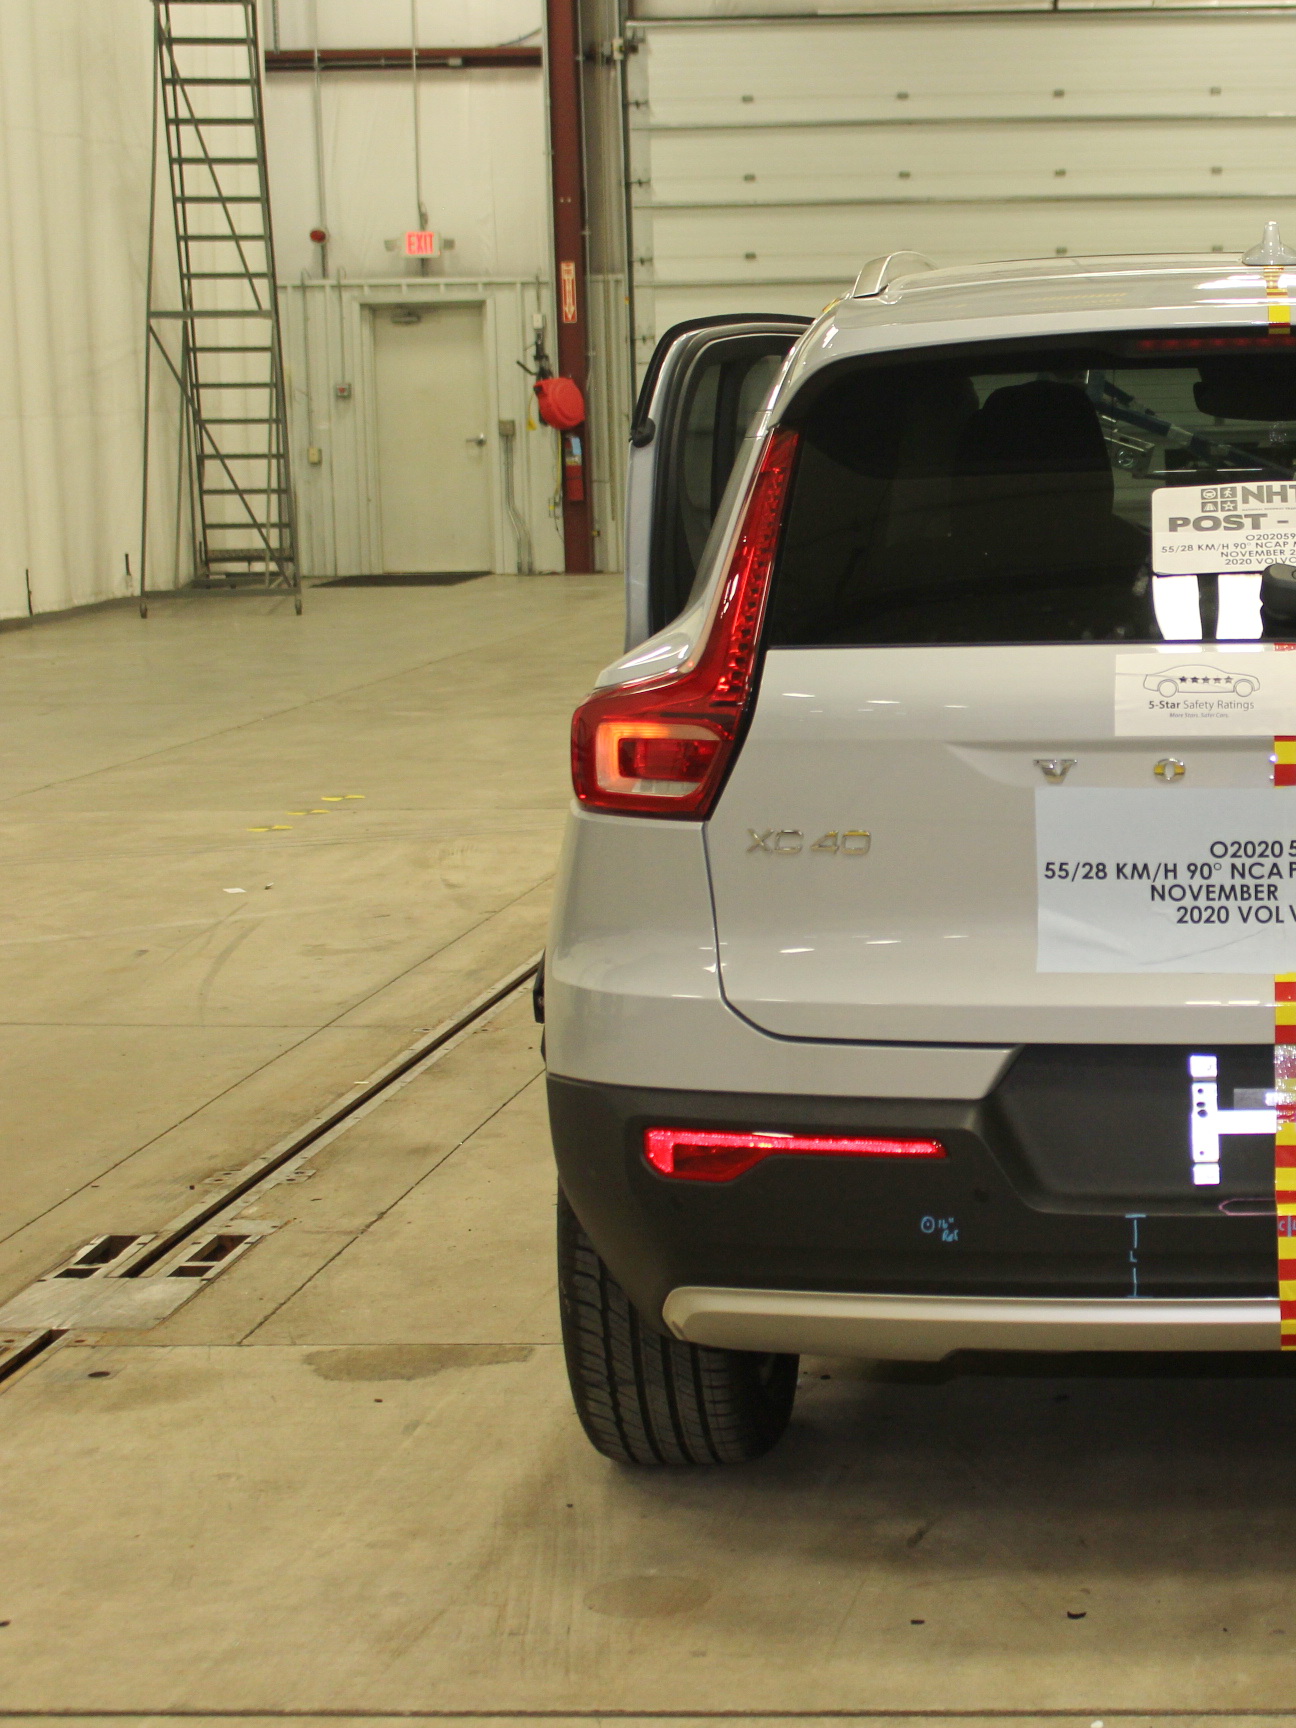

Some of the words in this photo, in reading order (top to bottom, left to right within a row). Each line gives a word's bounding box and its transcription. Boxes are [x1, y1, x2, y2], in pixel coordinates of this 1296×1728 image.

[407, 231, 434, 255] EXIT
[1168, 513, 1268, 532] POST
[1161, 544, 1194, 553] 55/28
[1197, 543, 1229, 552] KM/H
[1255, 541, 1289, 549] NCAP
[1220, 549, 1286, 558] NOVEMBER
[1224, 558, 1253, 566] 2020
[1149, 700, 1181, 710] 5-Star
[1183, 700, 1215, 712] Safety
[1217, 700, 1255, 712] Ratings
[1044, 861, 1109, 883] 55/28
[1116, 862, 1179, 883] KM/H
[1187, 862, 1223, 881] 90°
[1151, 883, 1279, 903] NOVEMBER
[1176, 905, 1230, 925] 2020
